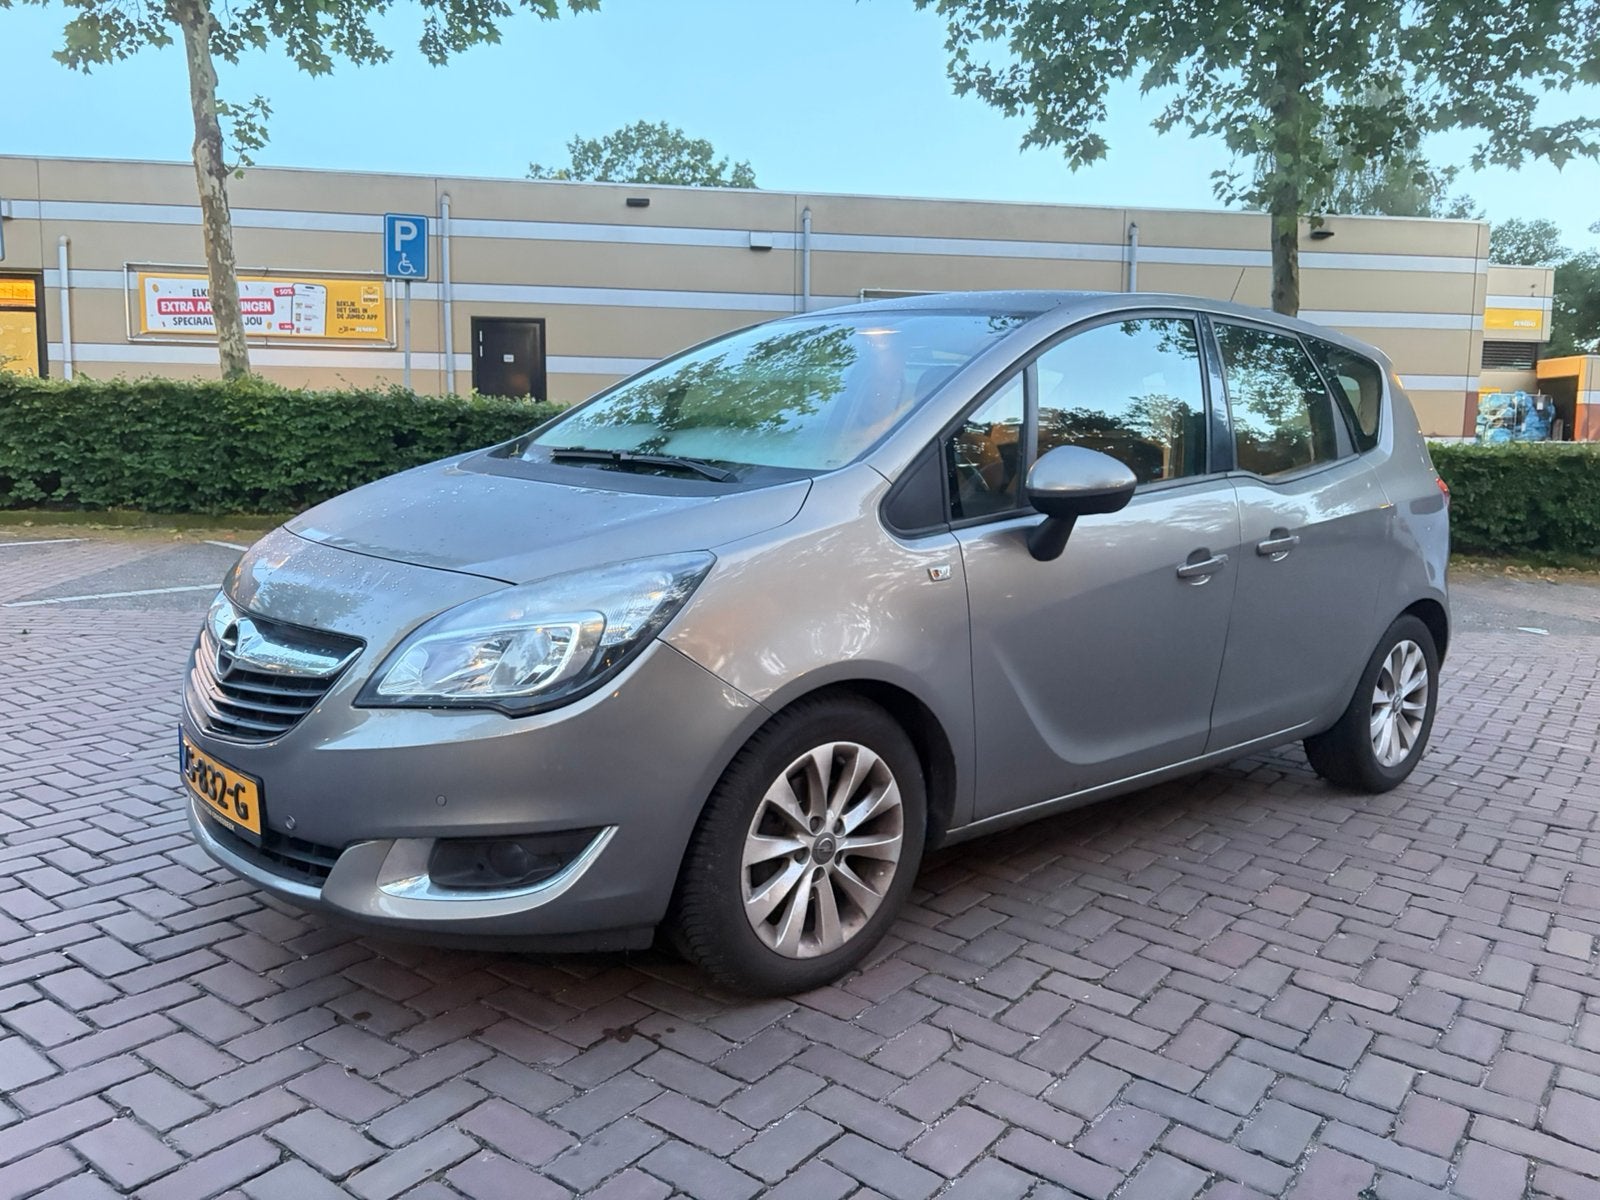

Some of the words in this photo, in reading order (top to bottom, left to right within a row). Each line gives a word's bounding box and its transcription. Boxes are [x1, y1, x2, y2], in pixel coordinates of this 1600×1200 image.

[395, 220, 417, 252] P
[161, 301, 194, 312] EXTRA
[173, 316, 213, 326] SPECIAAL
[245, 316, 262, 326] JOU
